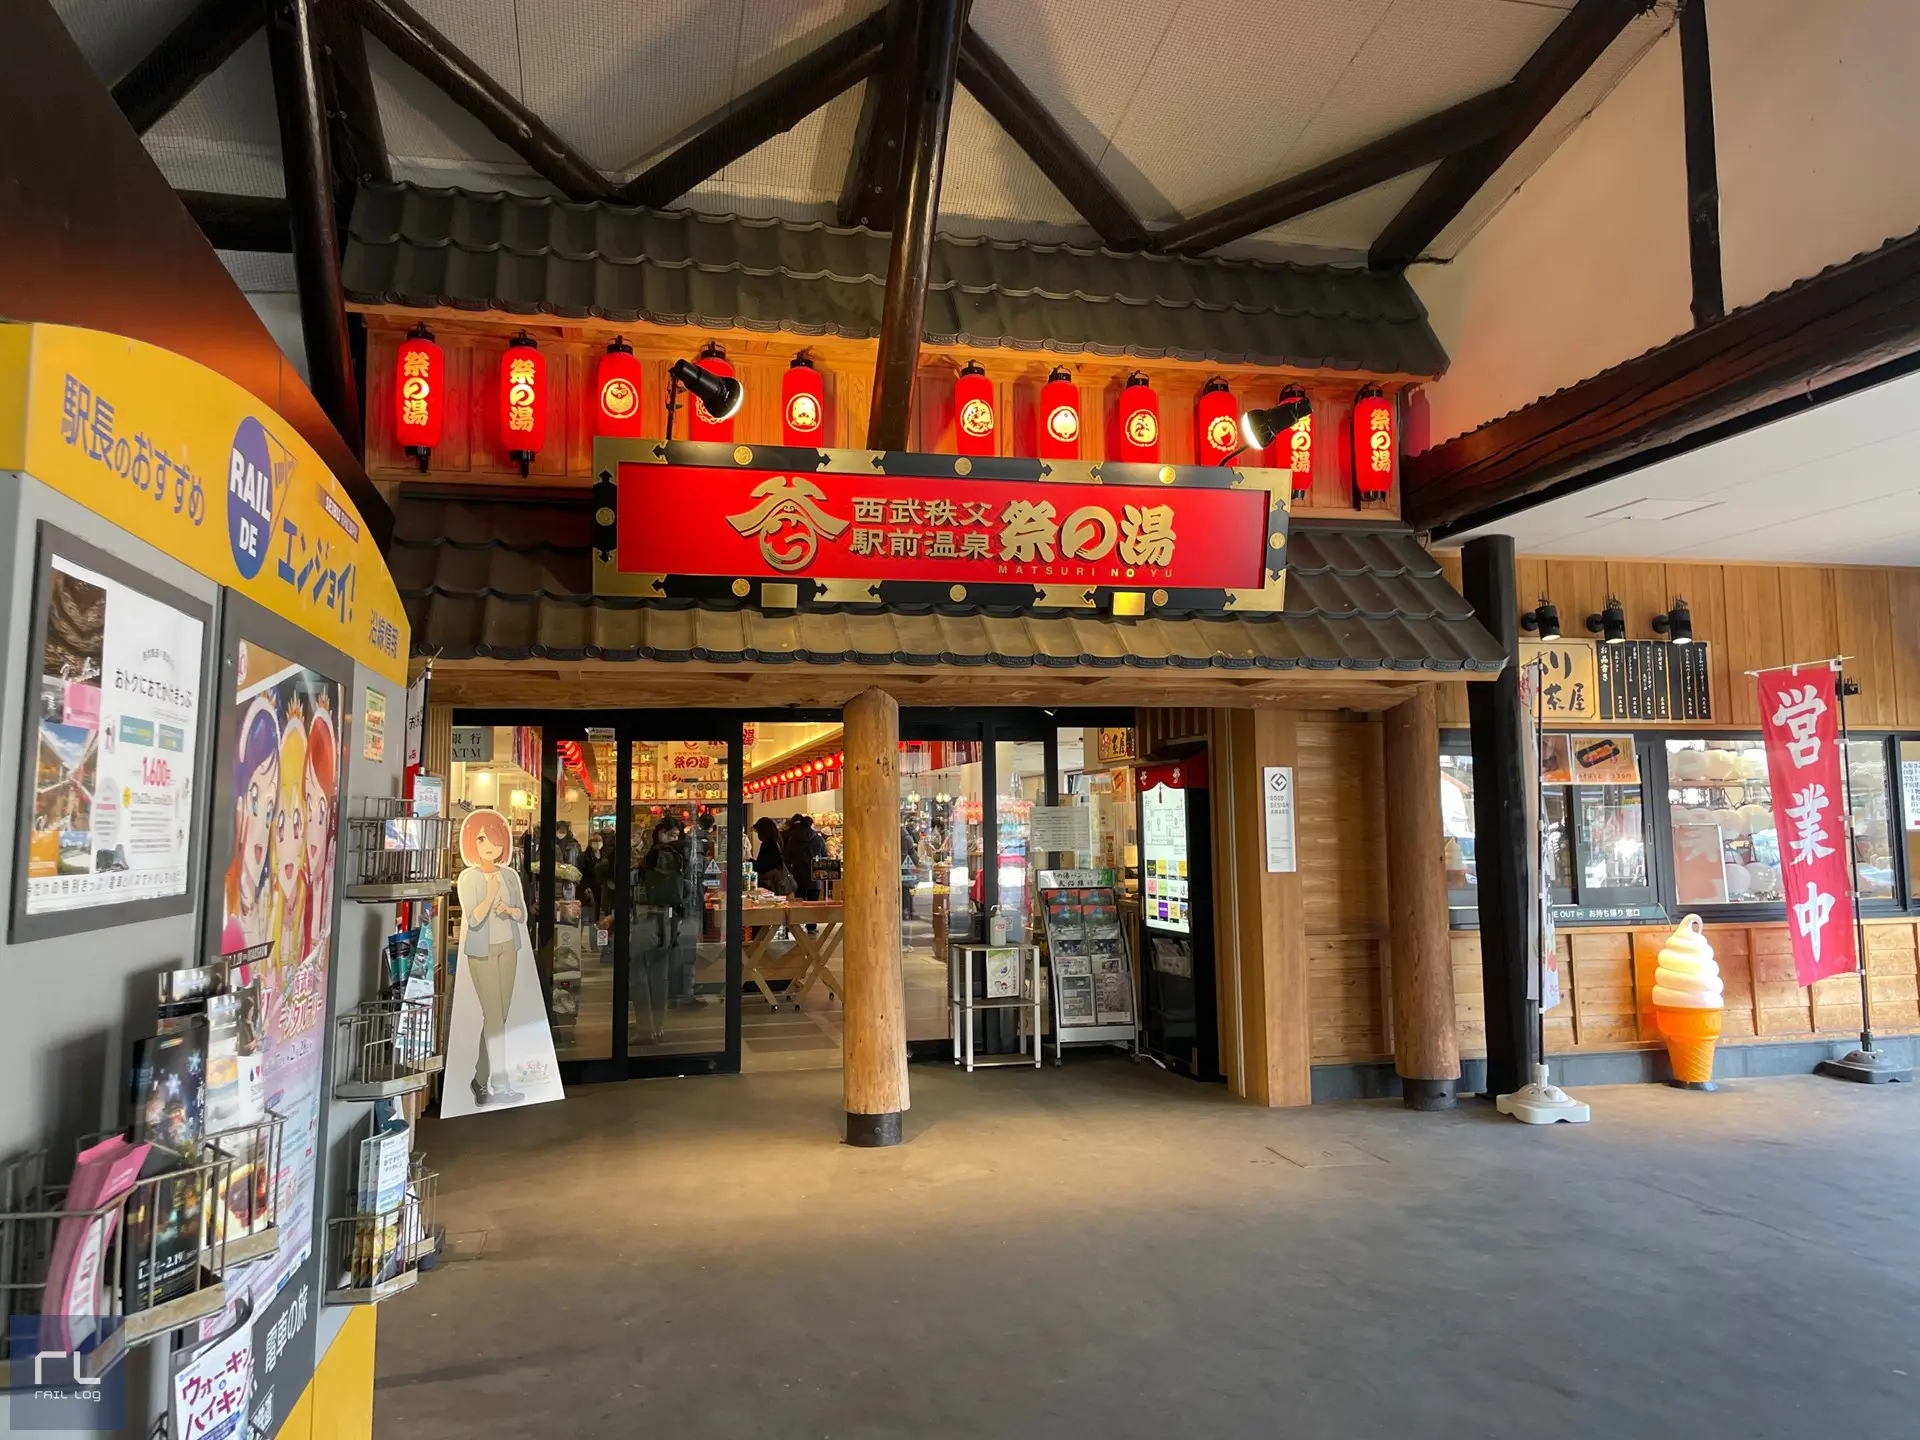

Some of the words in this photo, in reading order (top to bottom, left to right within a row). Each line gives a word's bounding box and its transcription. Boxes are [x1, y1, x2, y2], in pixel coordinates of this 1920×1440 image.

[402, 350, 430, 427] 祭の湯
[509, 358, 535, 433] 祭の湯
[61, 372, 206, 527] 駅長のおすすめ
[1370, 408, 1391, 474] 祭の湯
[228, 446, 272, 522] RAIL
[851, 496, 993, 527] 西武秩父
[239, 516, 259, 558] DE
[849, 528, 993, 560] 駅前温泉
[1000, 499, 1176, 567] 祭の湯
[277, 517, 358, 625] エンジョイ!
[998, 565, 1096, 577] MATSURI
[1110, 567, 1136, 578] NO
[1150, 568, 1173, 579] YU
[1543, 682, 1586, 712] 茶屋
[674, 755, 710, 769] 祭の湯
[1771, 684, 1836, 964] 営業中
[1560, 910, 1575, 918] OUT
[1588, 909, 1624, 918] お持ち帰り
[1625, 908, 1641, 917] 窓口
[265, 1283, 309, 1374] 電車の旅
